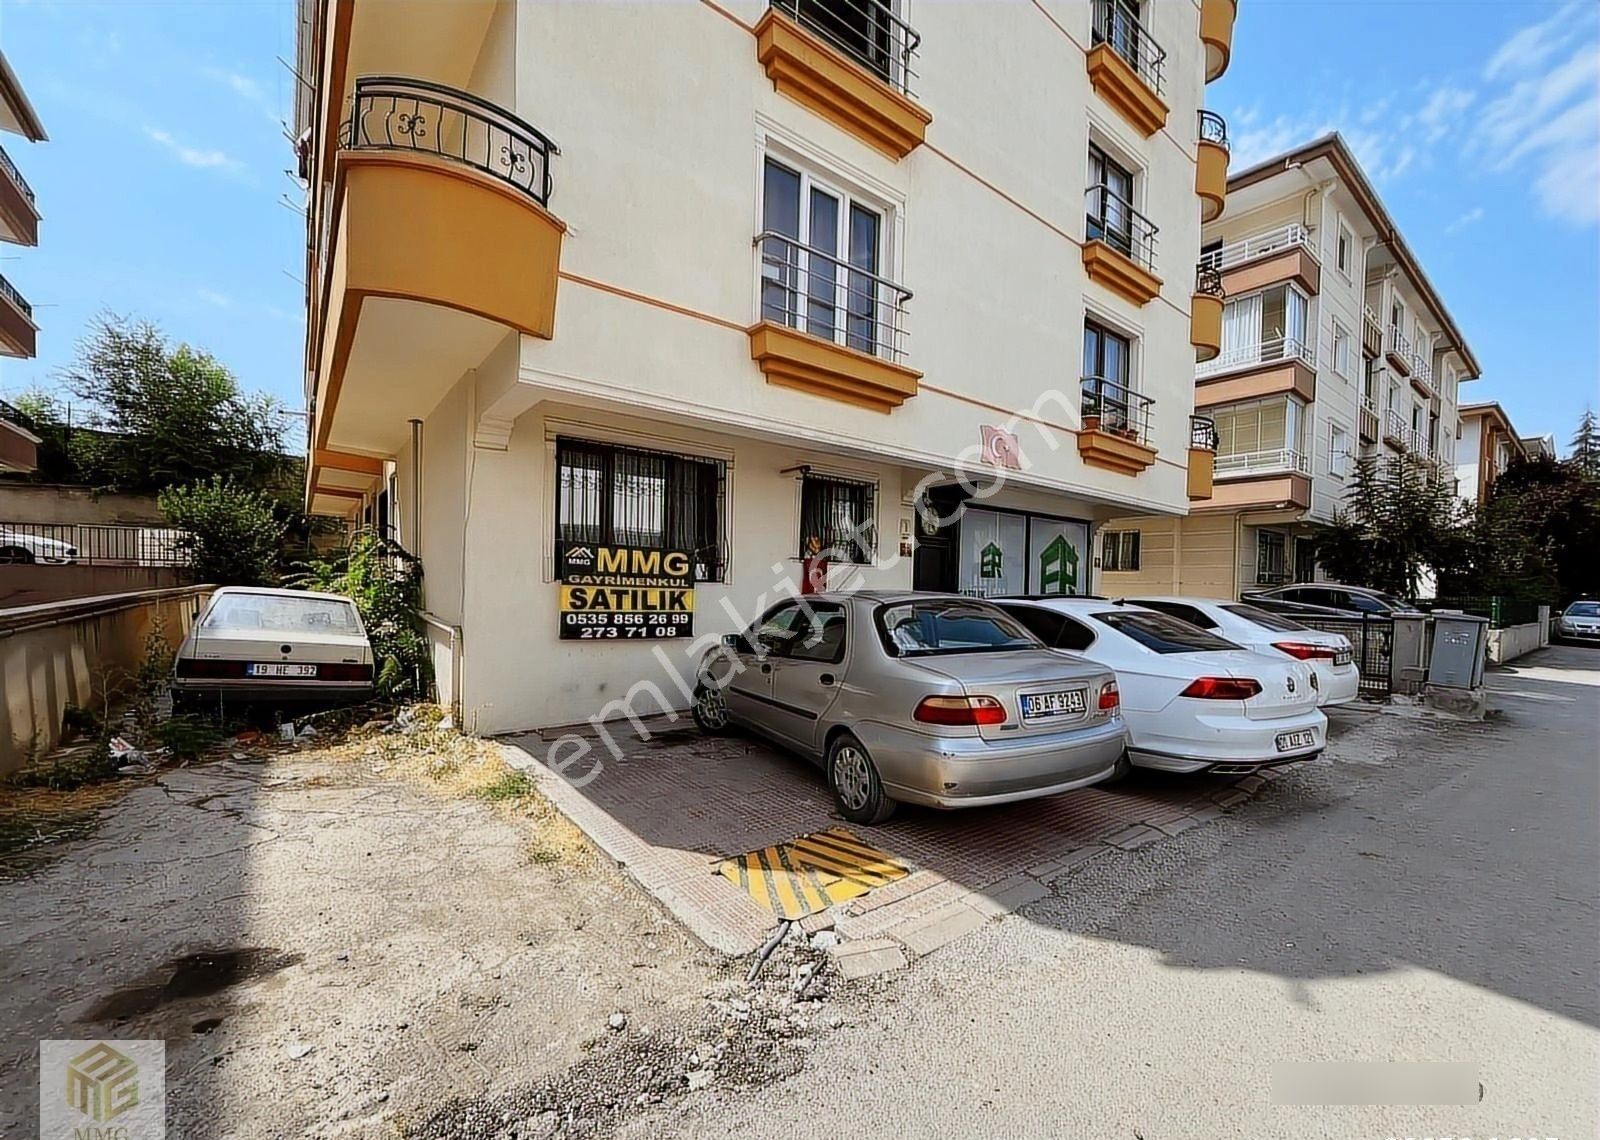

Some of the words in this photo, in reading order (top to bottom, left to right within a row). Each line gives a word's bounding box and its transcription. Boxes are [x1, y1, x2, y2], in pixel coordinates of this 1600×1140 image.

[568, 558, 591, 566] MMG
[597, 547, 689, 576] MMG
[568, 574, 689, 587] GAYRİMENKUL
[569, 587, 688, 611] SATILIK
[566, 613, 608, 625] 0535
[613, 614, 644, 625] 856
[648, 614, 667, 625] 26
[671, 614, 689, 624] 99
[580, 627, 618, 638] 273
[625, 627, 647, 637] 71
[655, 626, 677, 637] 08
[256, 664, 269, 675] 19
[275, 665, 289, 675] HE
[297, 665, 316, 676] 392
[1029, 697, 1041, 711] 06
